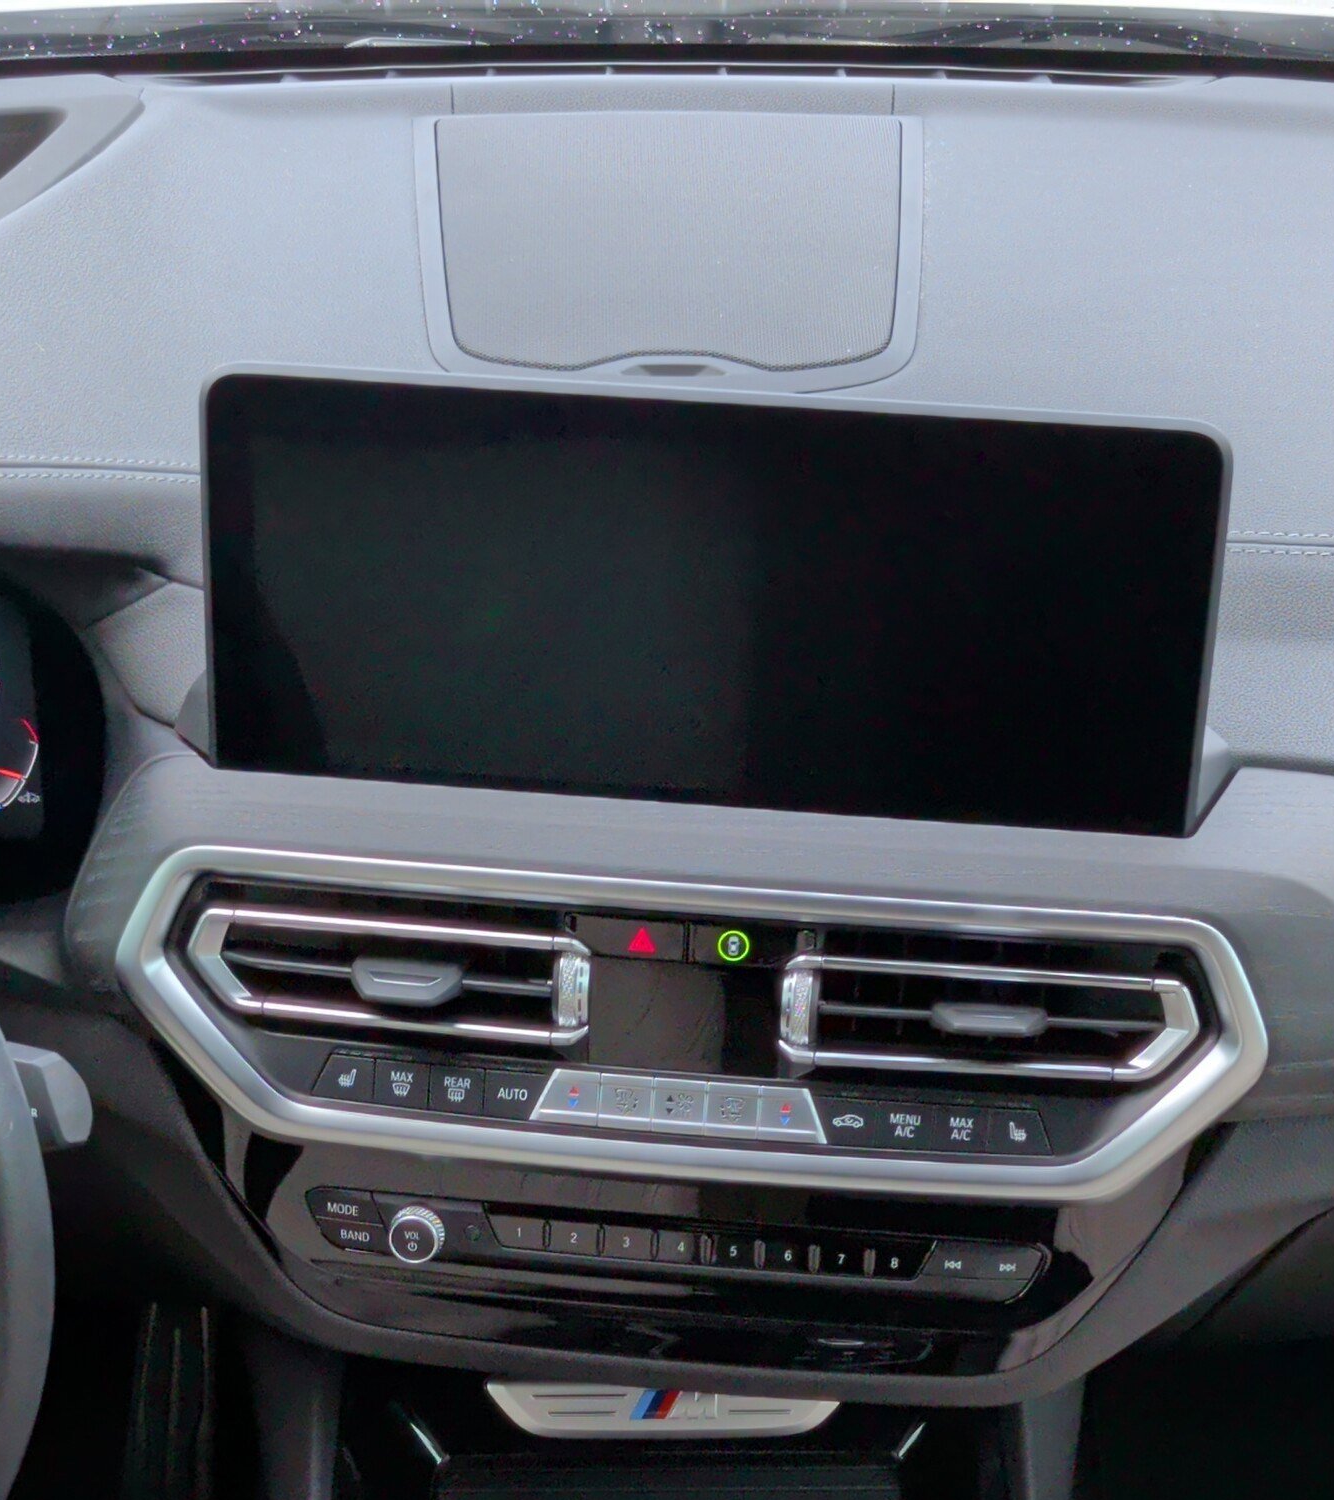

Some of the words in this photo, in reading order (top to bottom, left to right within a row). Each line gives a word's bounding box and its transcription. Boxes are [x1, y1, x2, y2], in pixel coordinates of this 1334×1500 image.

[390, 1070, 414, 1083] MAX
[444, 1076, 471, 1089] REAR
[497, 1087, 528, 1102] AUTO
[890, 1112, 921, 1126] MENU
[949, 1116, 974, 1129] MAX
[894, 1125, 915, 1138] A/C
[950, 1129, 971, 1141] A/C
[327, 1201, 359, 1217] MODE
[340, 1228, 370, 1243] BAND
[404, 1231, 419, 1241] VOL
[570, 1231, 579, 1244] 2
[621, 1236, 631, 1249] 3
[676, 1241, 686, 1253] 4
[729, 1245, 739, 1258] 5
[783, 1250, 793, 1262] 6
[836, 1253, 846, 1265] 7
[890, 1257, 900, 1270] 8
